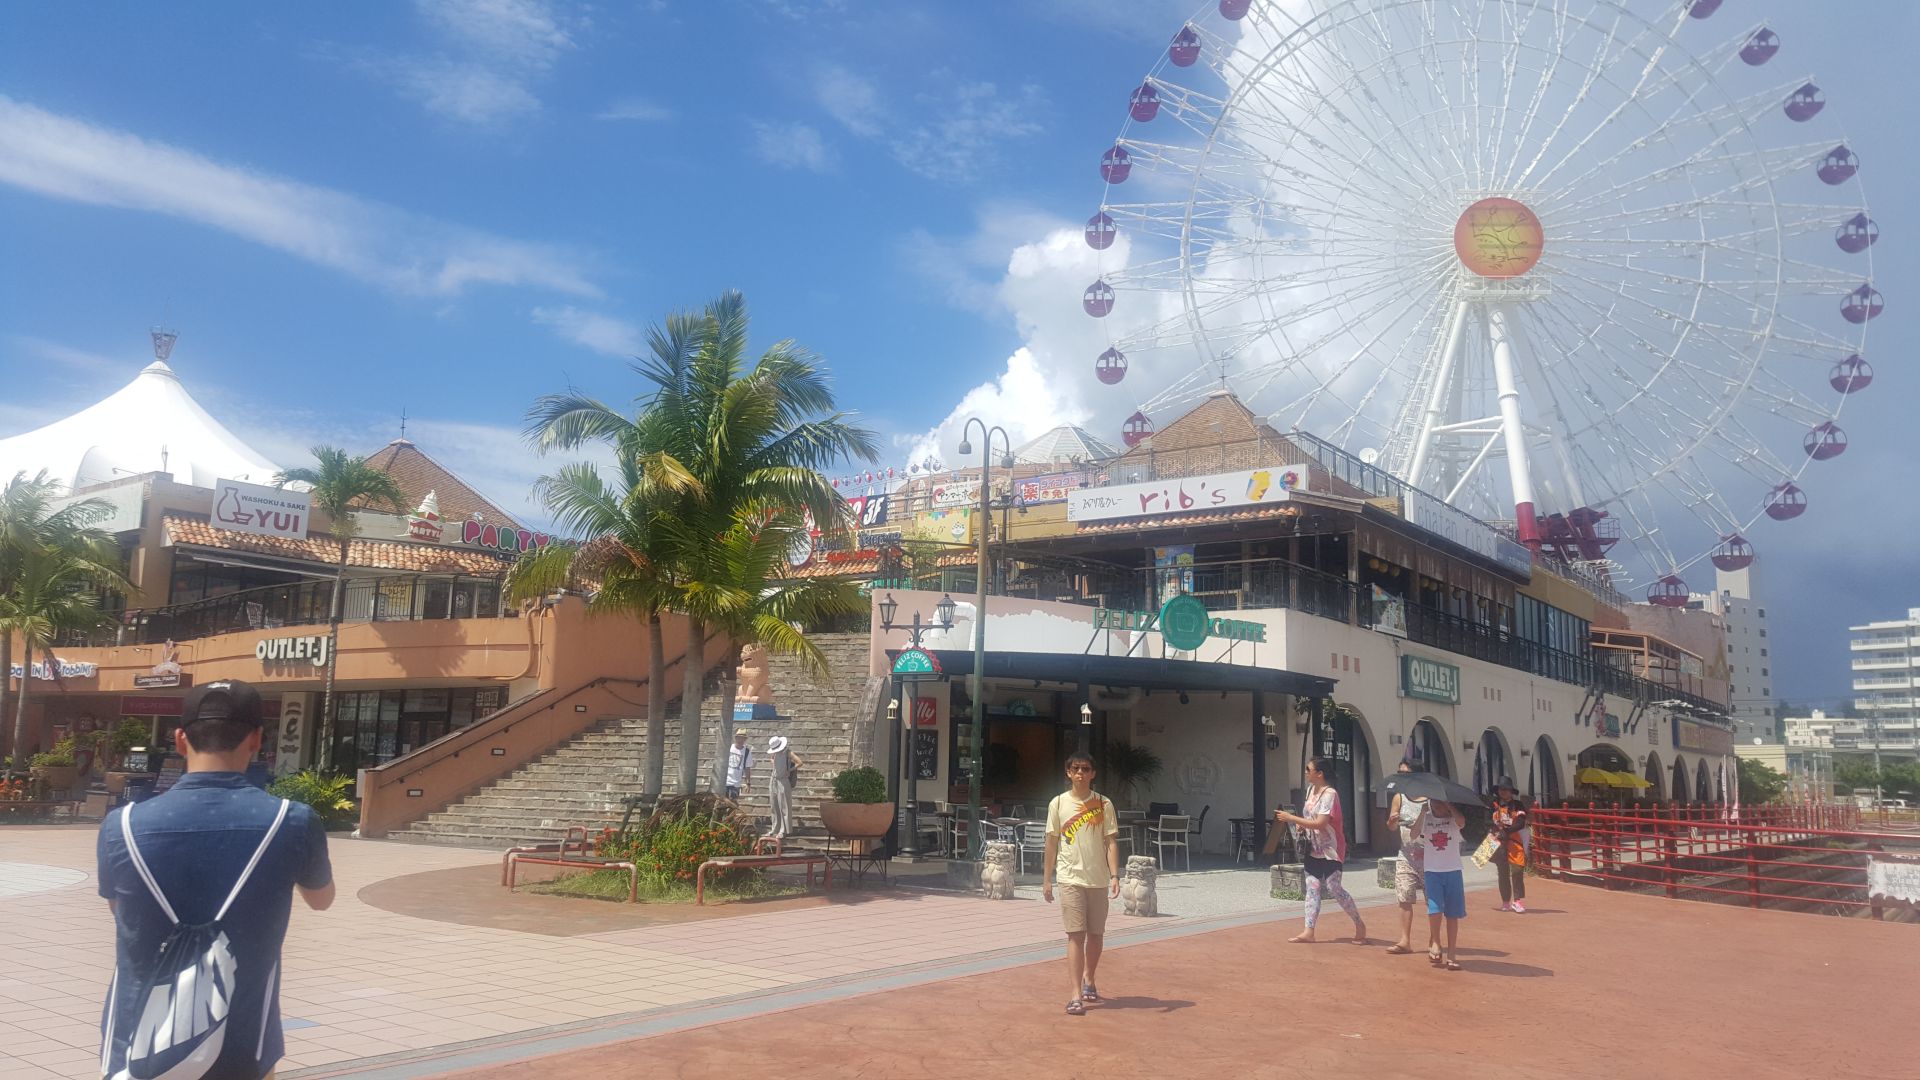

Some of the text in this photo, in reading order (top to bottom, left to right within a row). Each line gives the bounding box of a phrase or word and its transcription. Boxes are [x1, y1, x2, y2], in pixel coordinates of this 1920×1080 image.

[241, 495, 279, 507] WASHOKU
[287, 502, 306, 511] SAKE
[1023, 483, 1039, 501] 薬
[1139, 479, 1227, 513] rib's
[255, 509, 300, 533] YUI
[464, 519, 550, 553] PARTY
[1092, 607, 1267, 643] FELIZ COFFEE
[255, 636, 328, 667] OUTLET-J
[896, 652, 930, 669] FELIZ COFFEE
[1411, 659, 1458, 702] OUTLET-J
[1061, 807, 1102, 845] SUPERMAN
